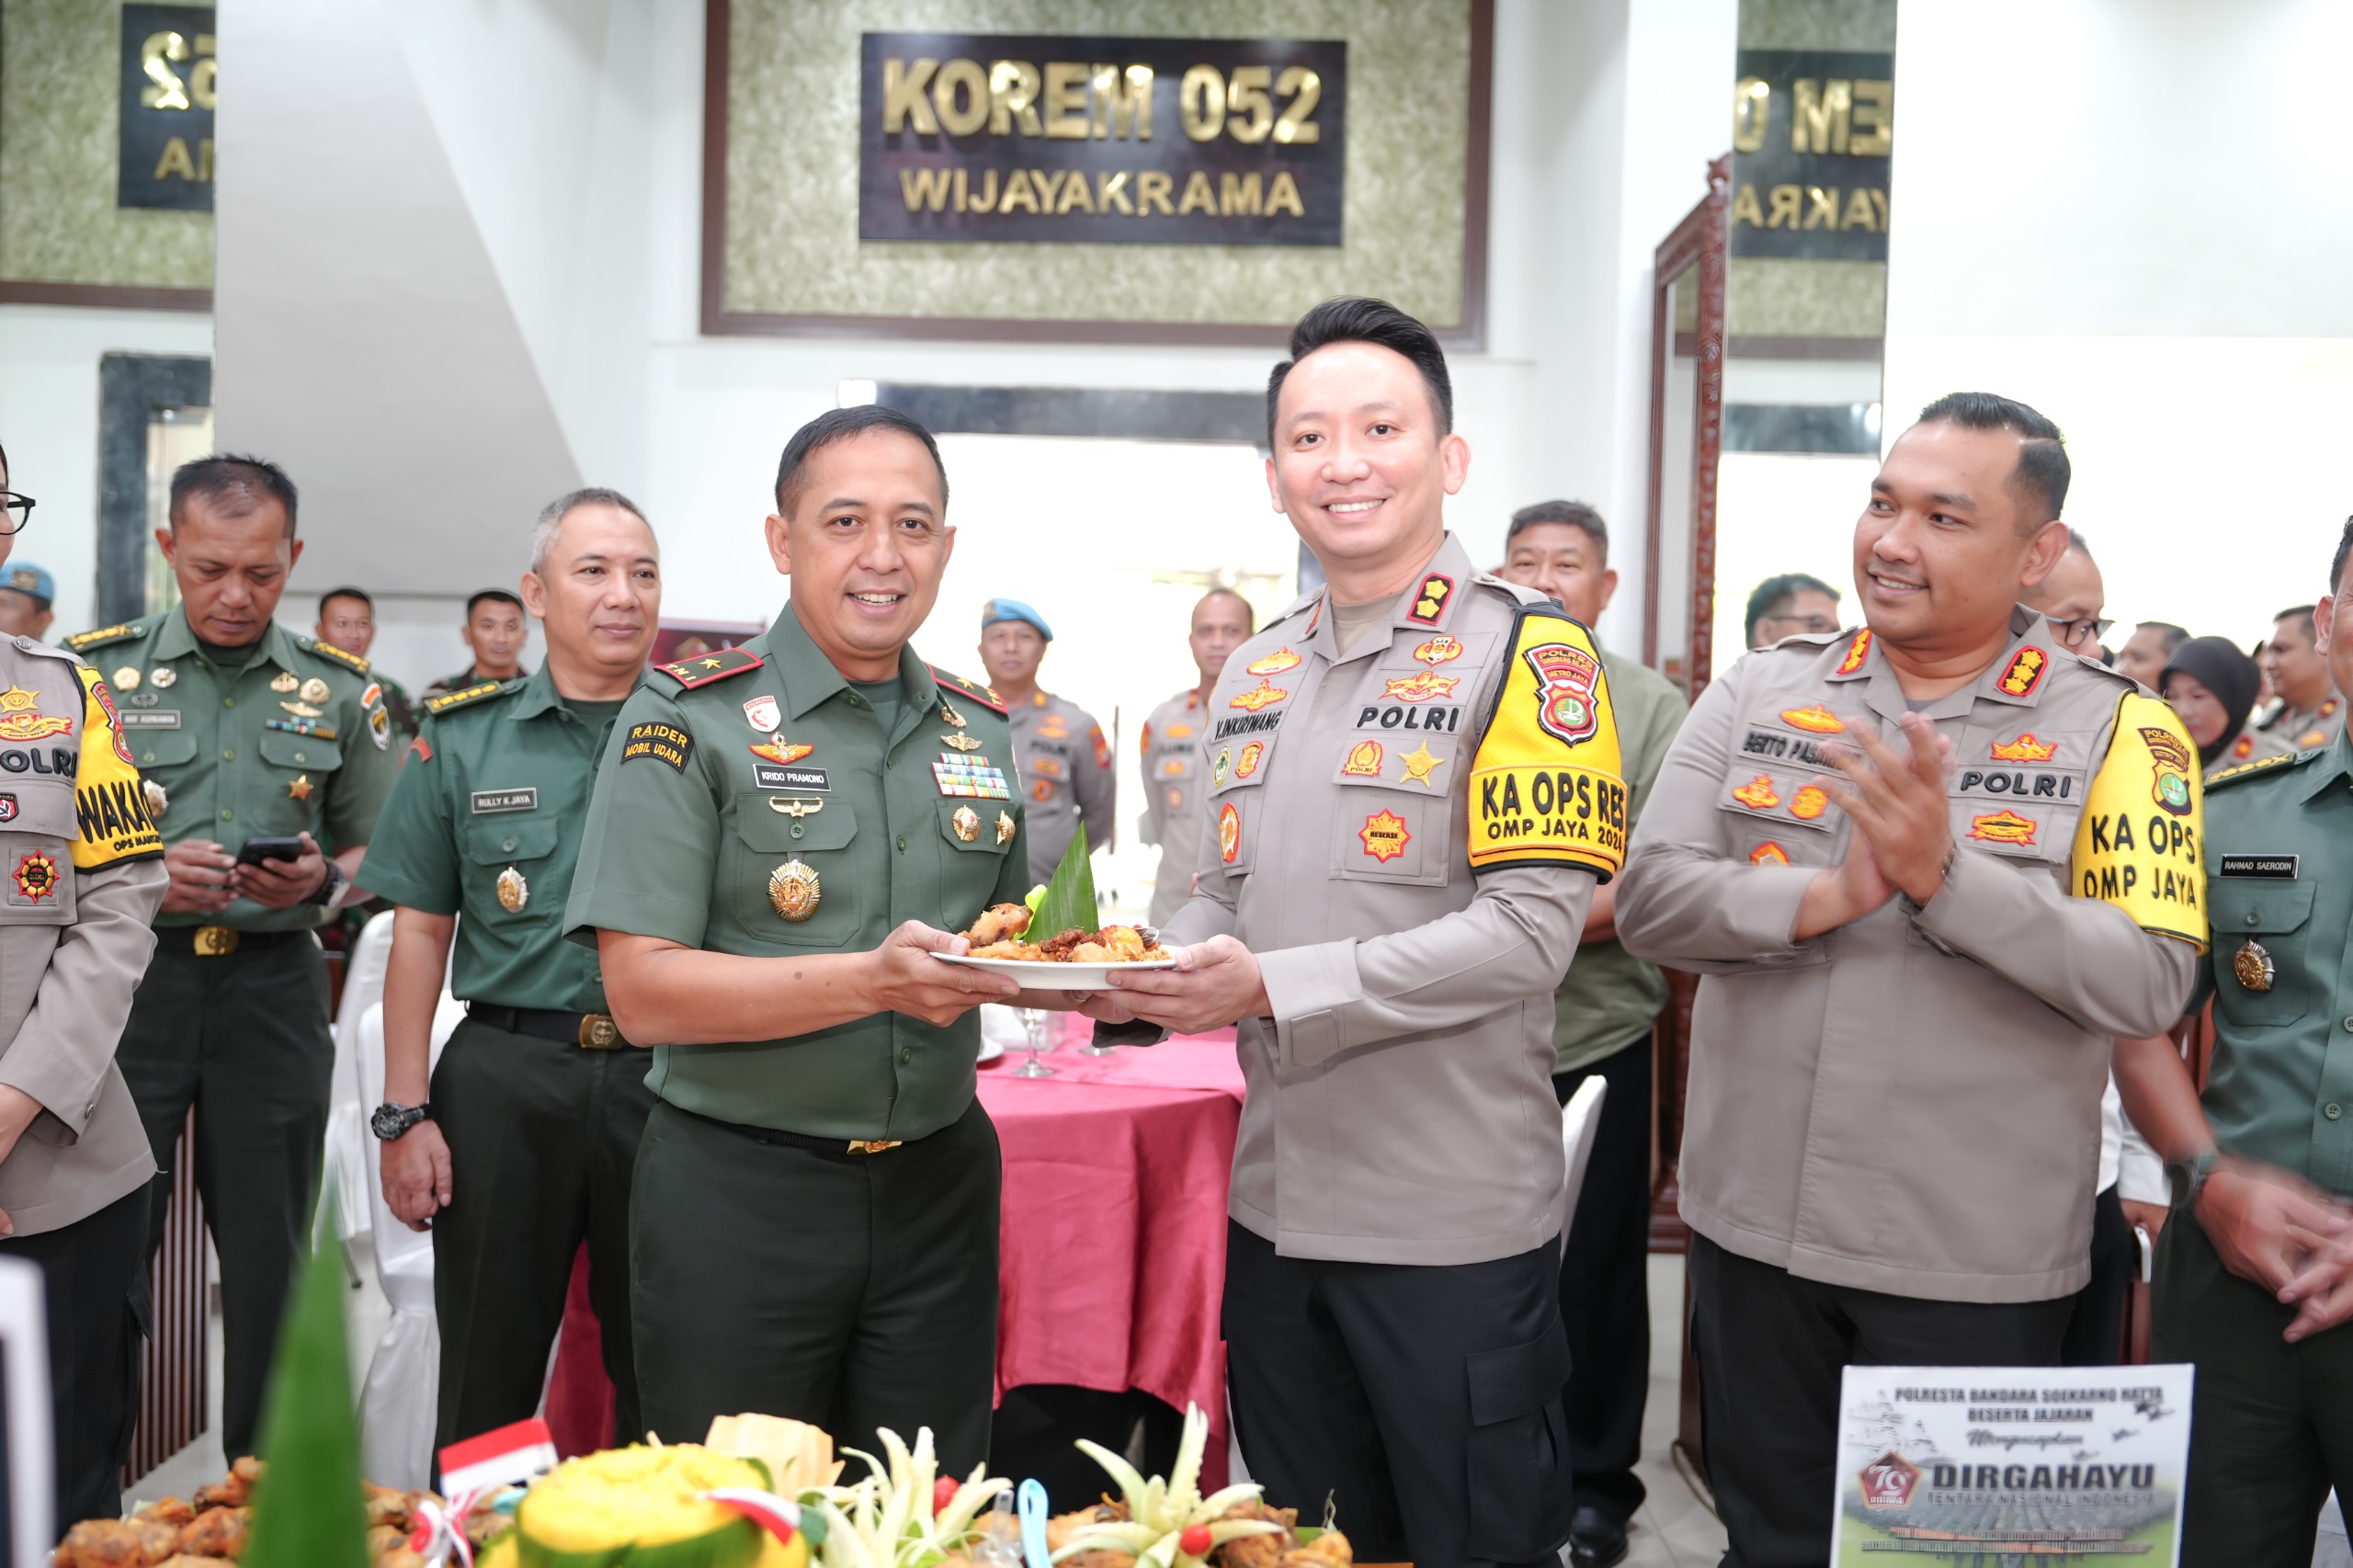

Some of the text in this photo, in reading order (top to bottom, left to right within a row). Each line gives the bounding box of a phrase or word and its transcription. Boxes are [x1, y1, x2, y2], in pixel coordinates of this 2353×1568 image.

[881, 57, 1322, 144] KOREM 052
[898, 167, 1305, 218] WIJAYAKRAMA
[665, 664, 697, 681] TNI
[1357, 706, 1460, 733] POLRI
[631, 724, 688, 749] RAIDER
[0, 747, 78, 779] OLRI
[625, 742, 683, 767] MOBIL UDARA
[761, 771, 824, 784] KRIDO PRAMONO
[1960, 771, 2072, 798] POLRI
[478, 797, 503, 808] RULLY
[511, 794, 531, 805] JAYA
[1483, 771, 1624, 832] KA OPS RES
[114, 837, 134, 852] OPS
[1370, 831, 1399, 839] RESERSE
[1488, 818, 1622, 853] OMP JAYA 2024
[2092, 813, 2196, 865] KA OPS
[2224, 860, 2292, 871] RAHMAD SAERODIN
[2084, 866, 2197, 911] OMP JAYA
[1895, 1386, 2163, 1403] POLRESTA BANDARA SOEKARNO HATTA
[1967, 1407, 2093, 1422] BESERTA JAJARAN
[1932, 1463, 2155, 1490] DIRGAHAYU
